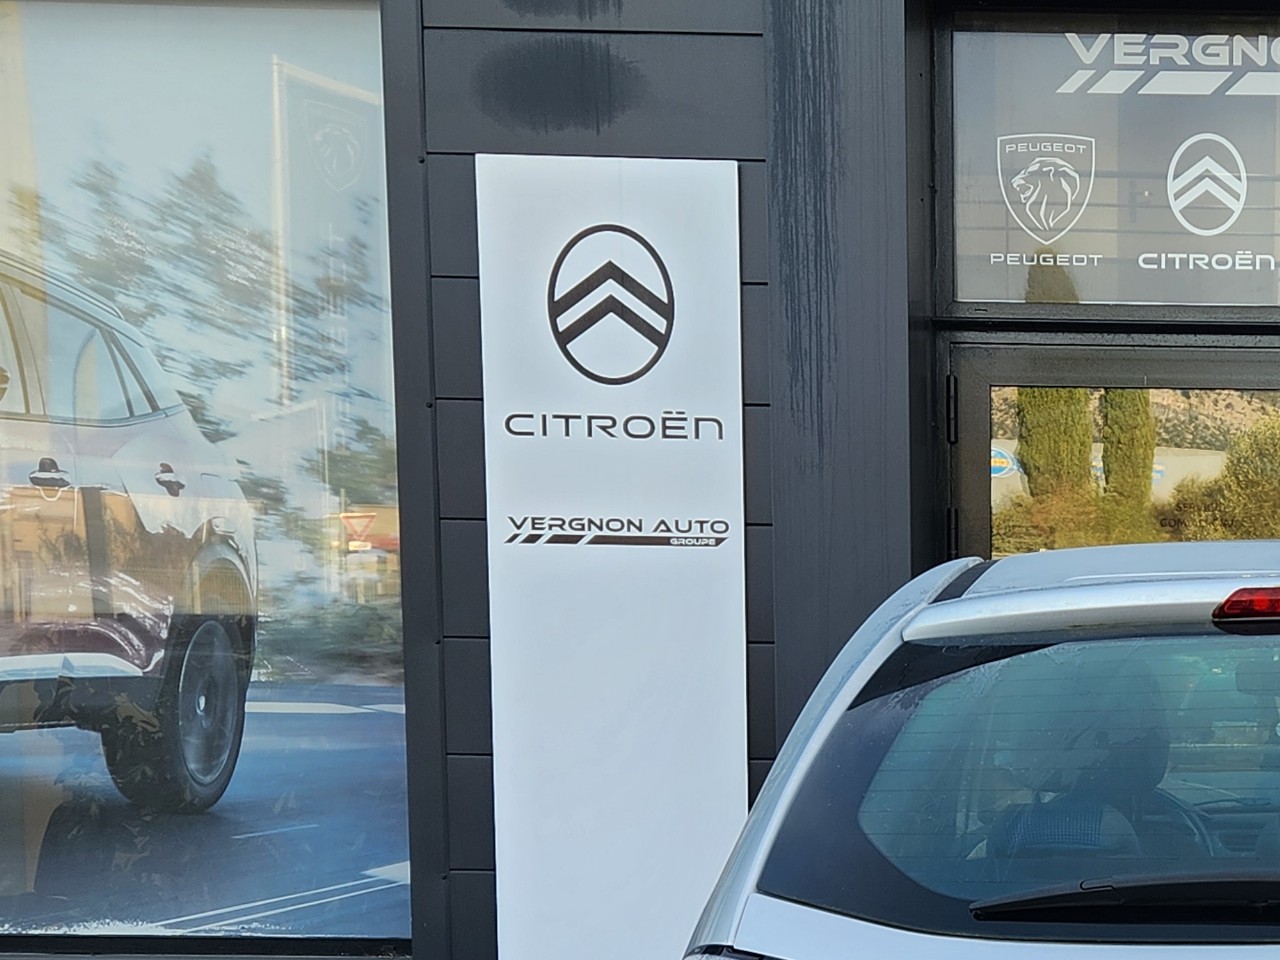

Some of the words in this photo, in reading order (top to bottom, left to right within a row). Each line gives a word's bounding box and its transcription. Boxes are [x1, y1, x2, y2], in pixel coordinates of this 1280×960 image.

[1005, 142, 1087, 154] PEUGEOT
[989, 253, 1104, 266] PEUGEOT
[507, 515, 644, 533] VERGNON
[651, 517, 730, 535] AUTO
[669, 537, 717, 546] GROUPE
